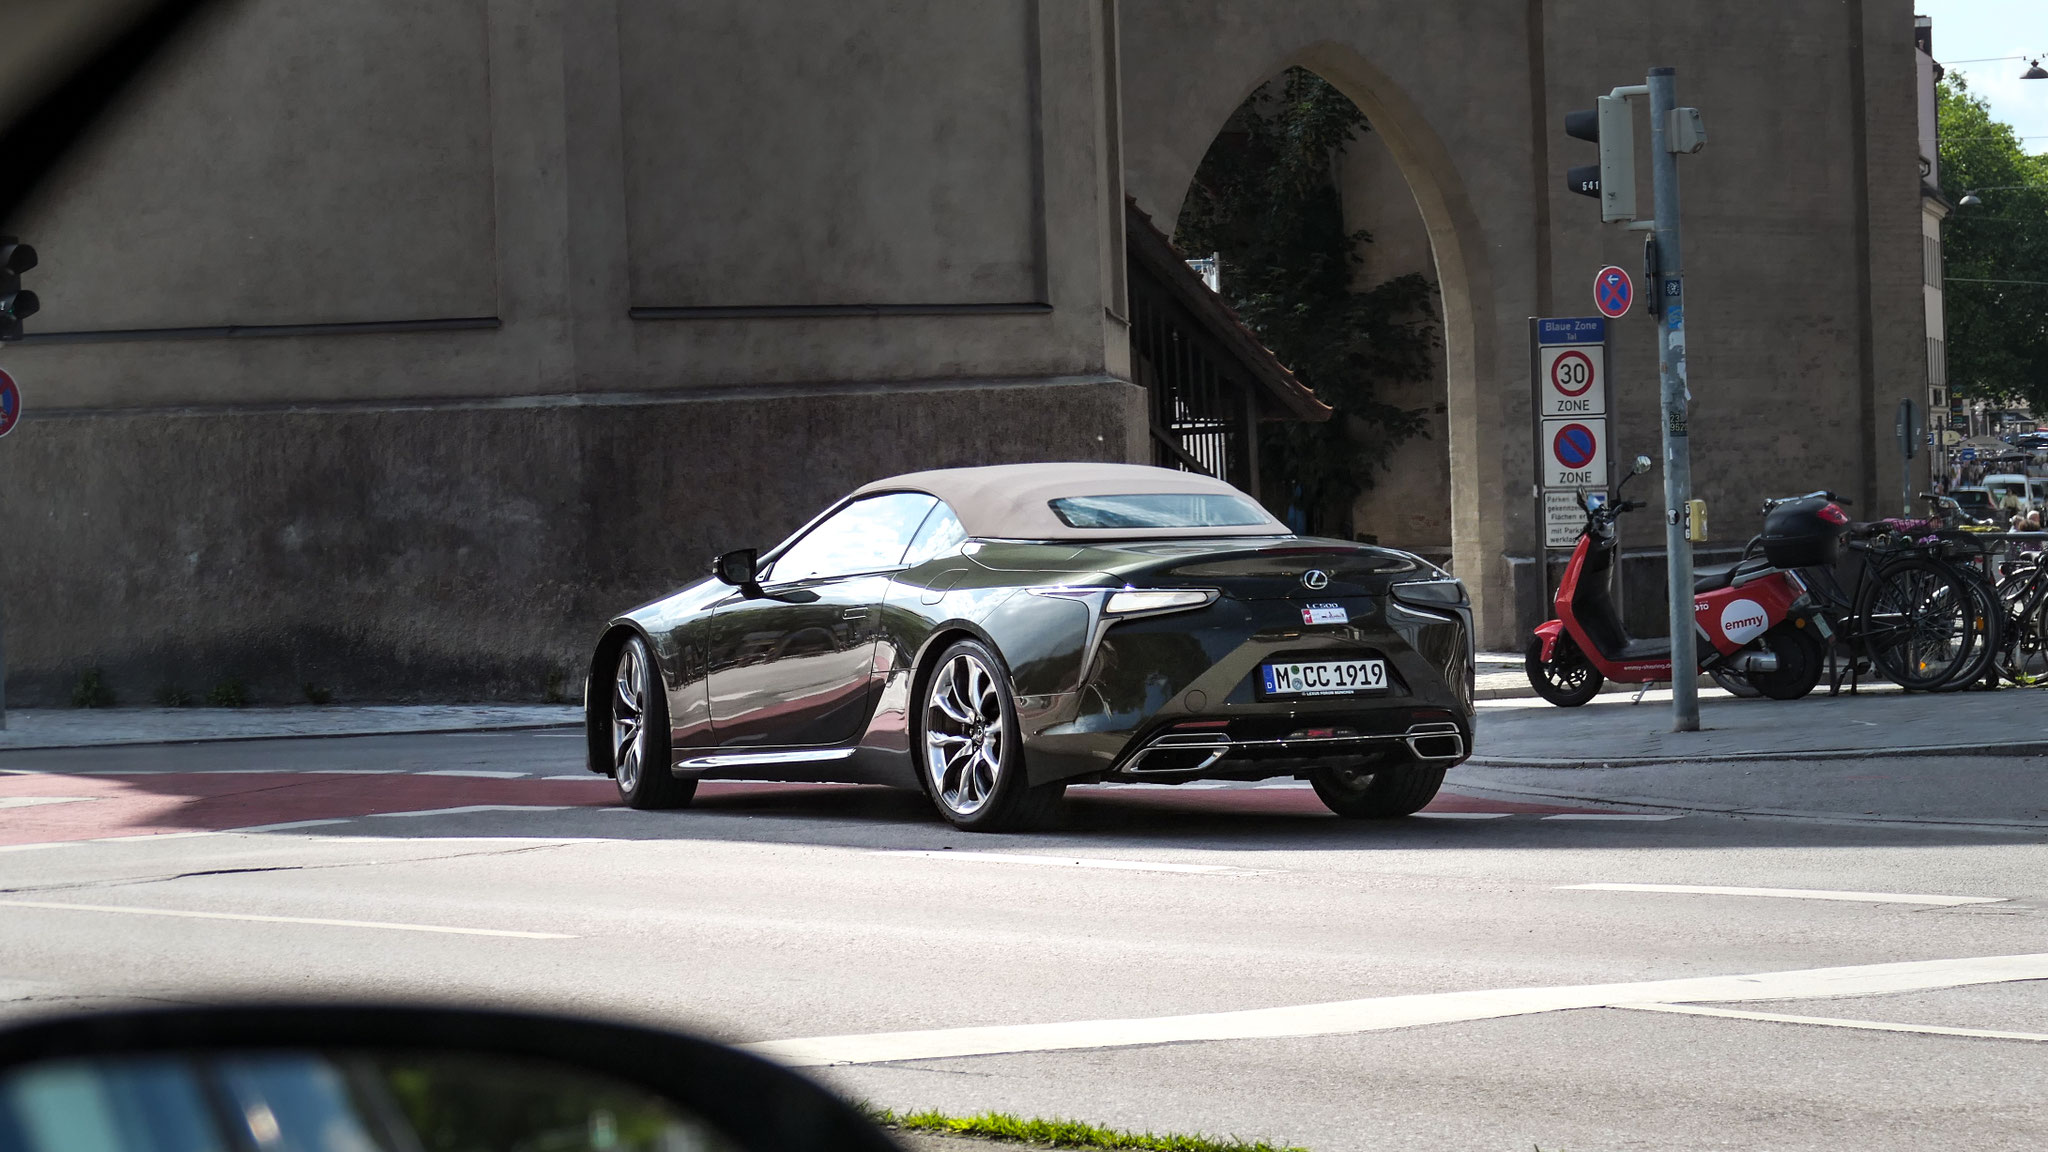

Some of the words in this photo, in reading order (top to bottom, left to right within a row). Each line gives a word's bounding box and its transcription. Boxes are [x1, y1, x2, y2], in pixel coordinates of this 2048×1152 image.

[1582, 181, 1599, 191] 541
[1545, 322, 1571, 331] Blaue
[1574, 321, 1597, 330] Zone
[1560, 363, 1585, 384] 30
[1557, 399, 1590, 412] ZONE
[1951, 385, 1963, 428] BUTLRS
[1559, 471, 1592, 483] ZONE
[1725, 615, 1763, 631] emmy
[1275, 667, 1291, 689] M
[1303, 665, 1330, 687] CC
[1334, 663, 1383, 686] 1919
